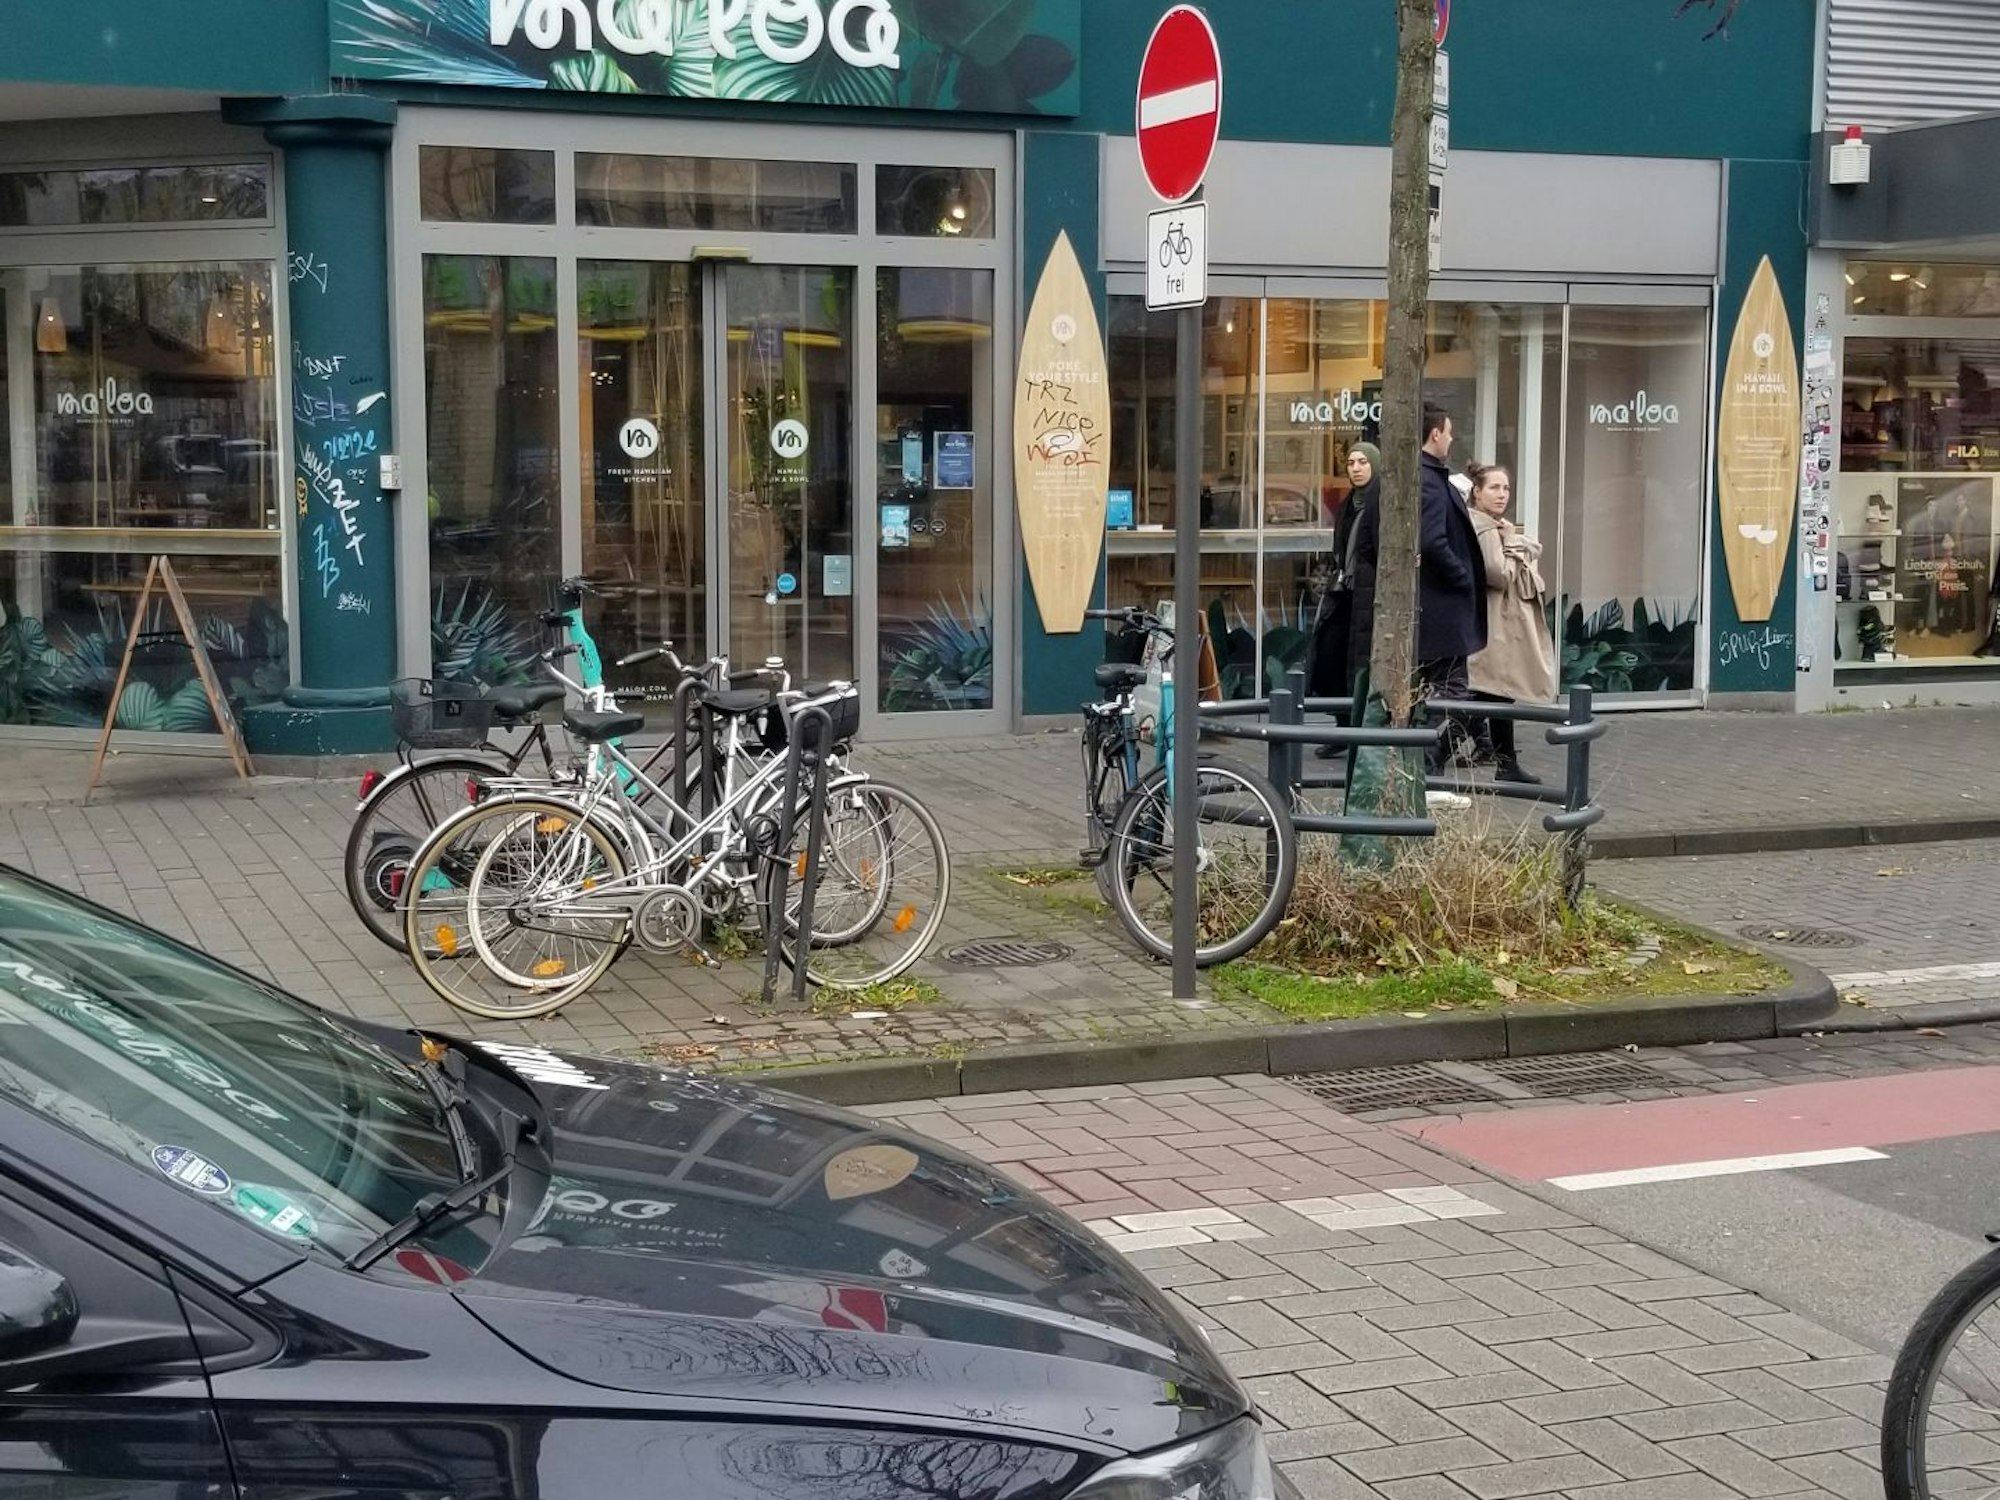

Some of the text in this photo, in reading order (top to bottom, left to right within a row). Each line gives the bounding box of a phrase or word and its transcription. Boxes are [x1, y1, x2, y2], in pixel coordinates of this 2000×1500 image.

[1167, 273, 1185, 294] frei
[1743, 373, 1782, 383] HAWAII
[1590, 390, 1679, 424] ma'loa
[1947, 444, 1980, 458] FILA
